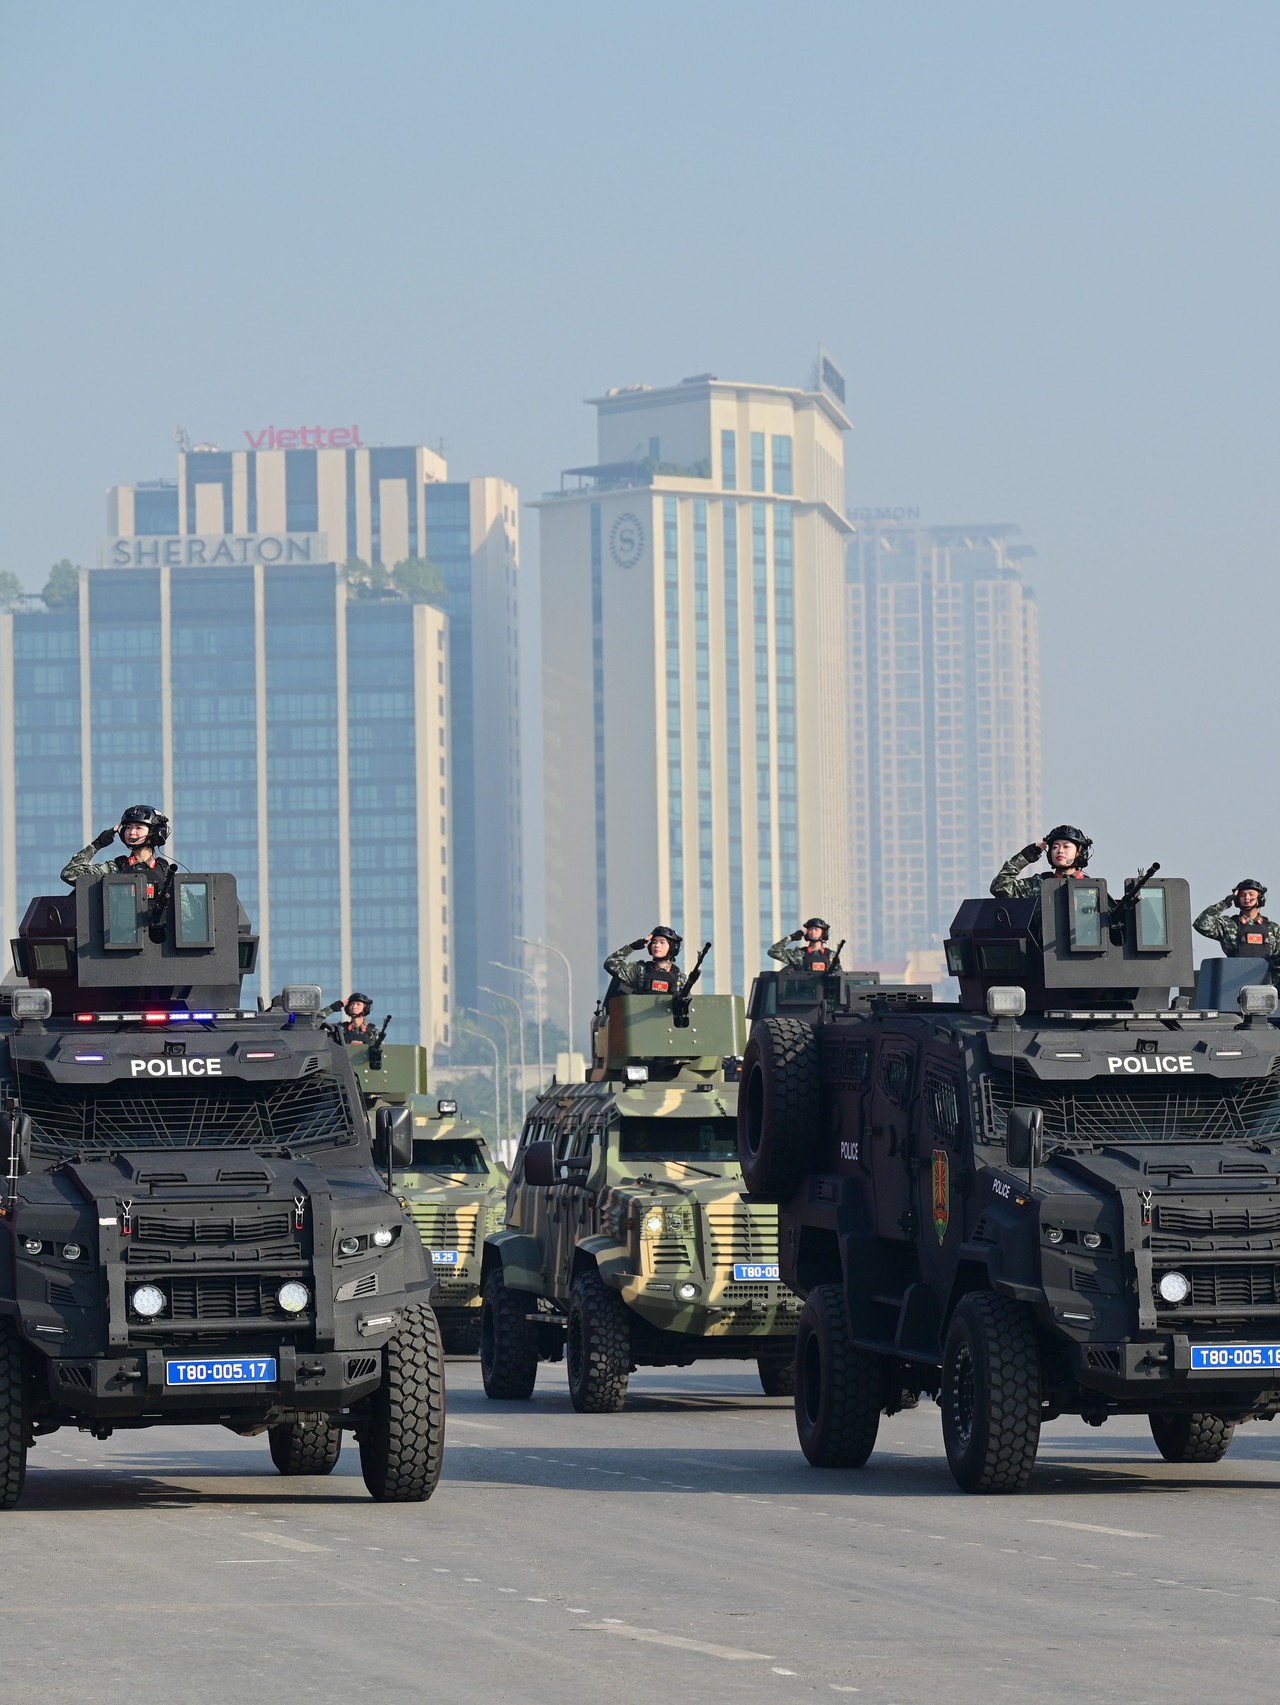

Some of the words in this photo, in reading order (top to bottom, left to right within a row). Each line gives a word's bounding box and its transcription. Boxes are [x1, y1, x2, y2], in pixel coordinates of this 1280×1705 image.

[243, 424, 365, 449] viettel
[113, 536, 311, 565] SHERATON
[130, 1058, 222, 1077] POLICE
[1107, 1056, 1195, 1073] POLICE
[840, 1141, 859, 1160] POLICE
[991, 1178, 1011, 1199] POLICE
[176, 1362, 267, 1380] T80-005.17
